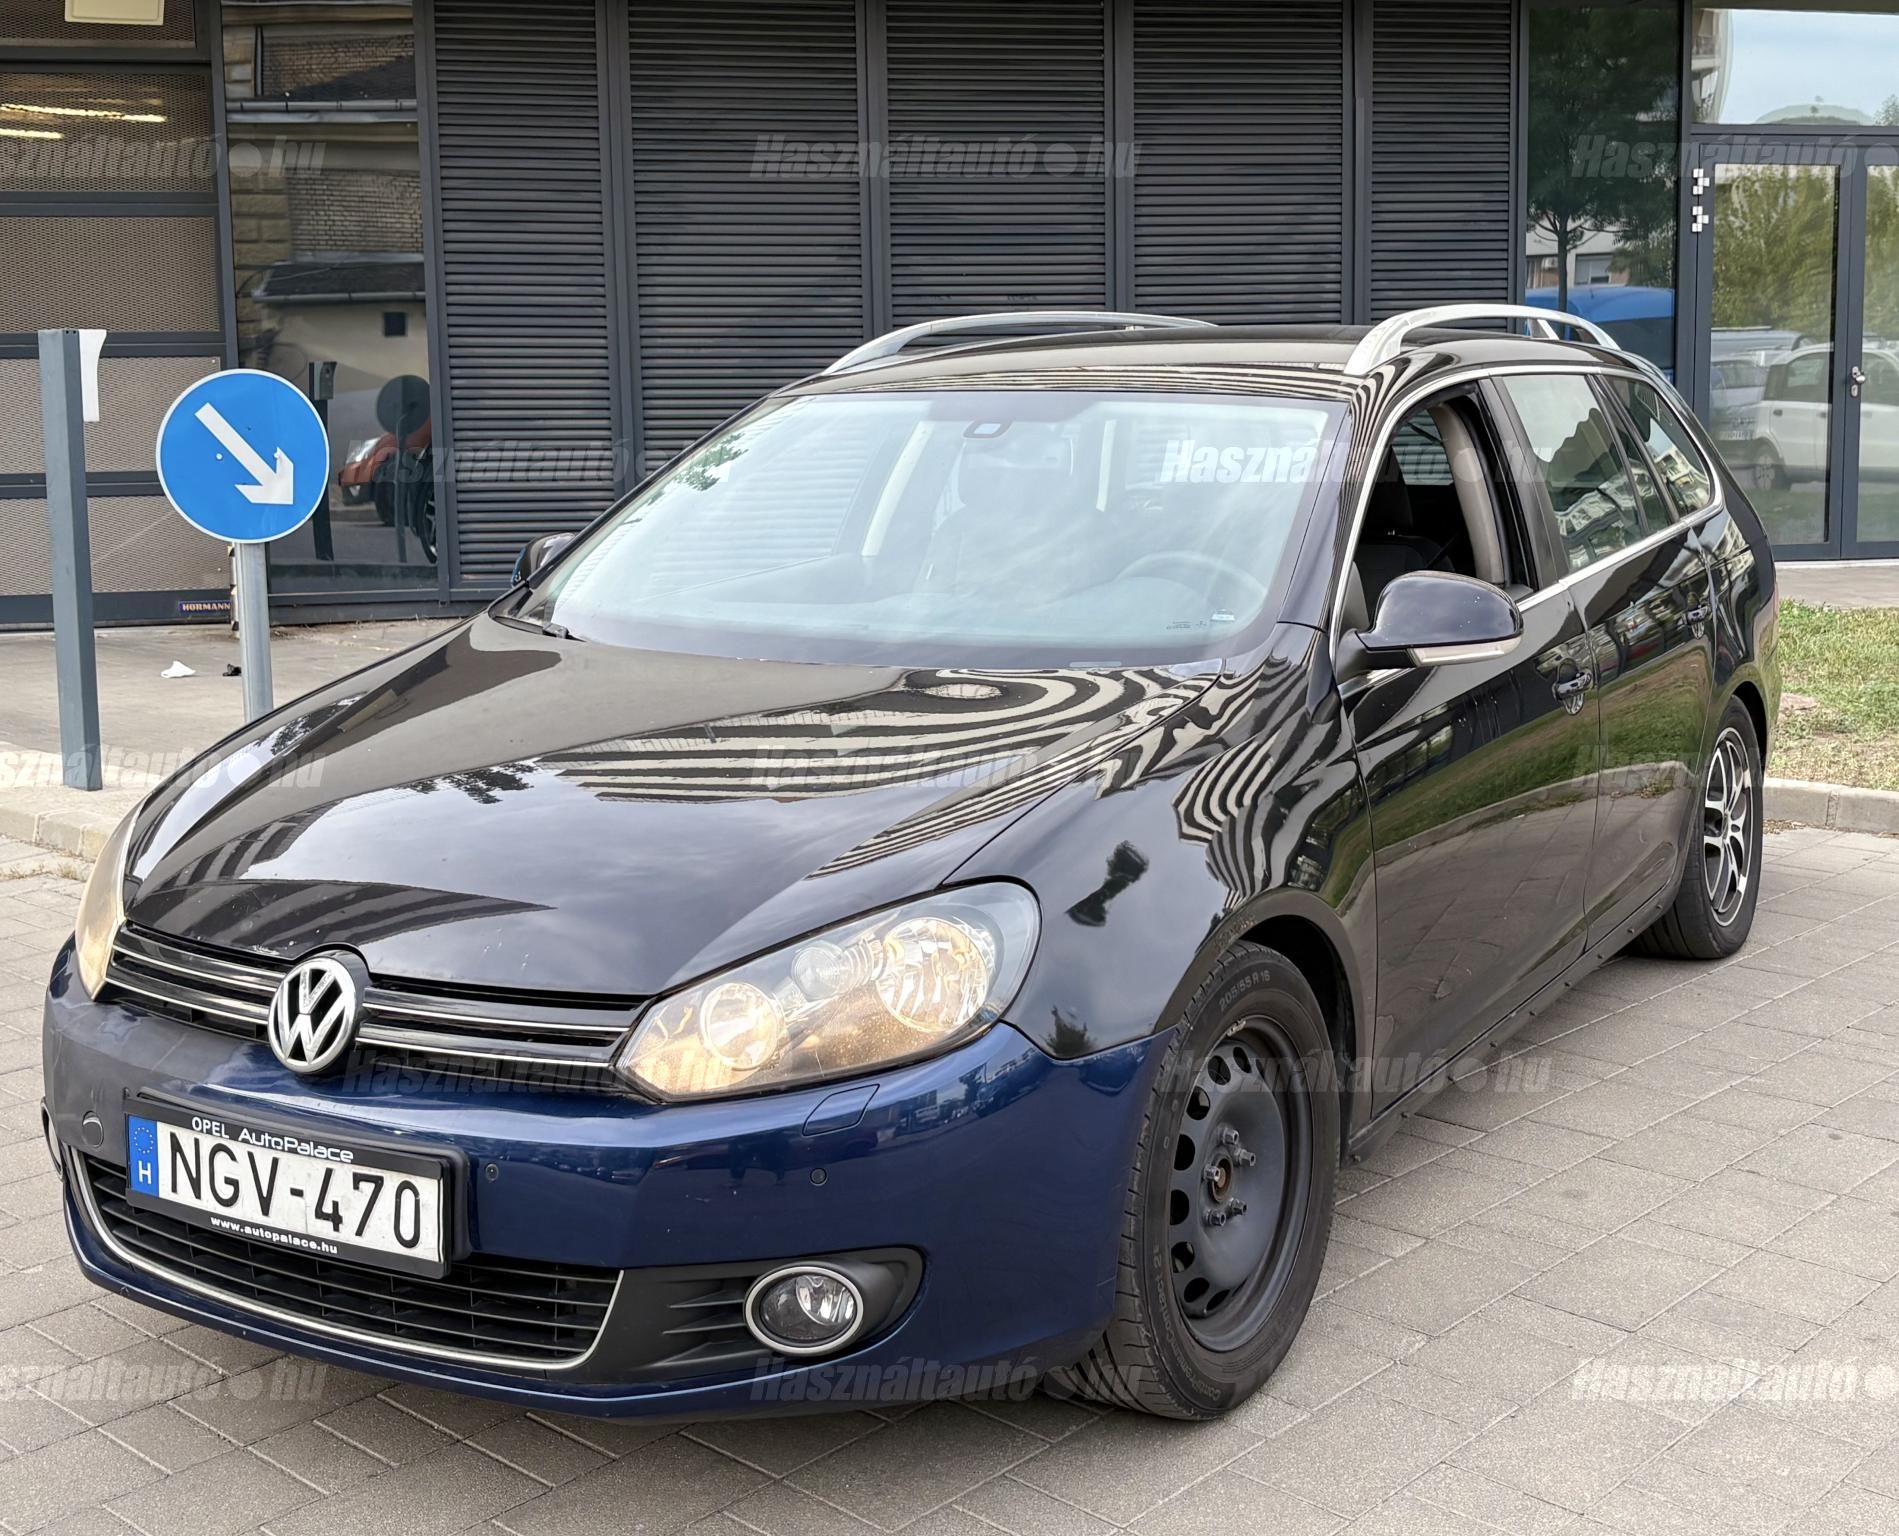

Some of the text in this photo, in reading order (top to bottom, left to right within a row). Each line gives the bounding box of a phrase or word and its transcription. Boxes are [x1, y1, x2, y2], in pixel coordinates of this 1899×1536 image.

[191, 1116, 354, 1163] OPEL AutoPalace
[138, 1161, 152, 1185] H
[169, 1131, 421, 1249] NGV-470
[210, 1215, 338, 1255] www.autopalace.hu
